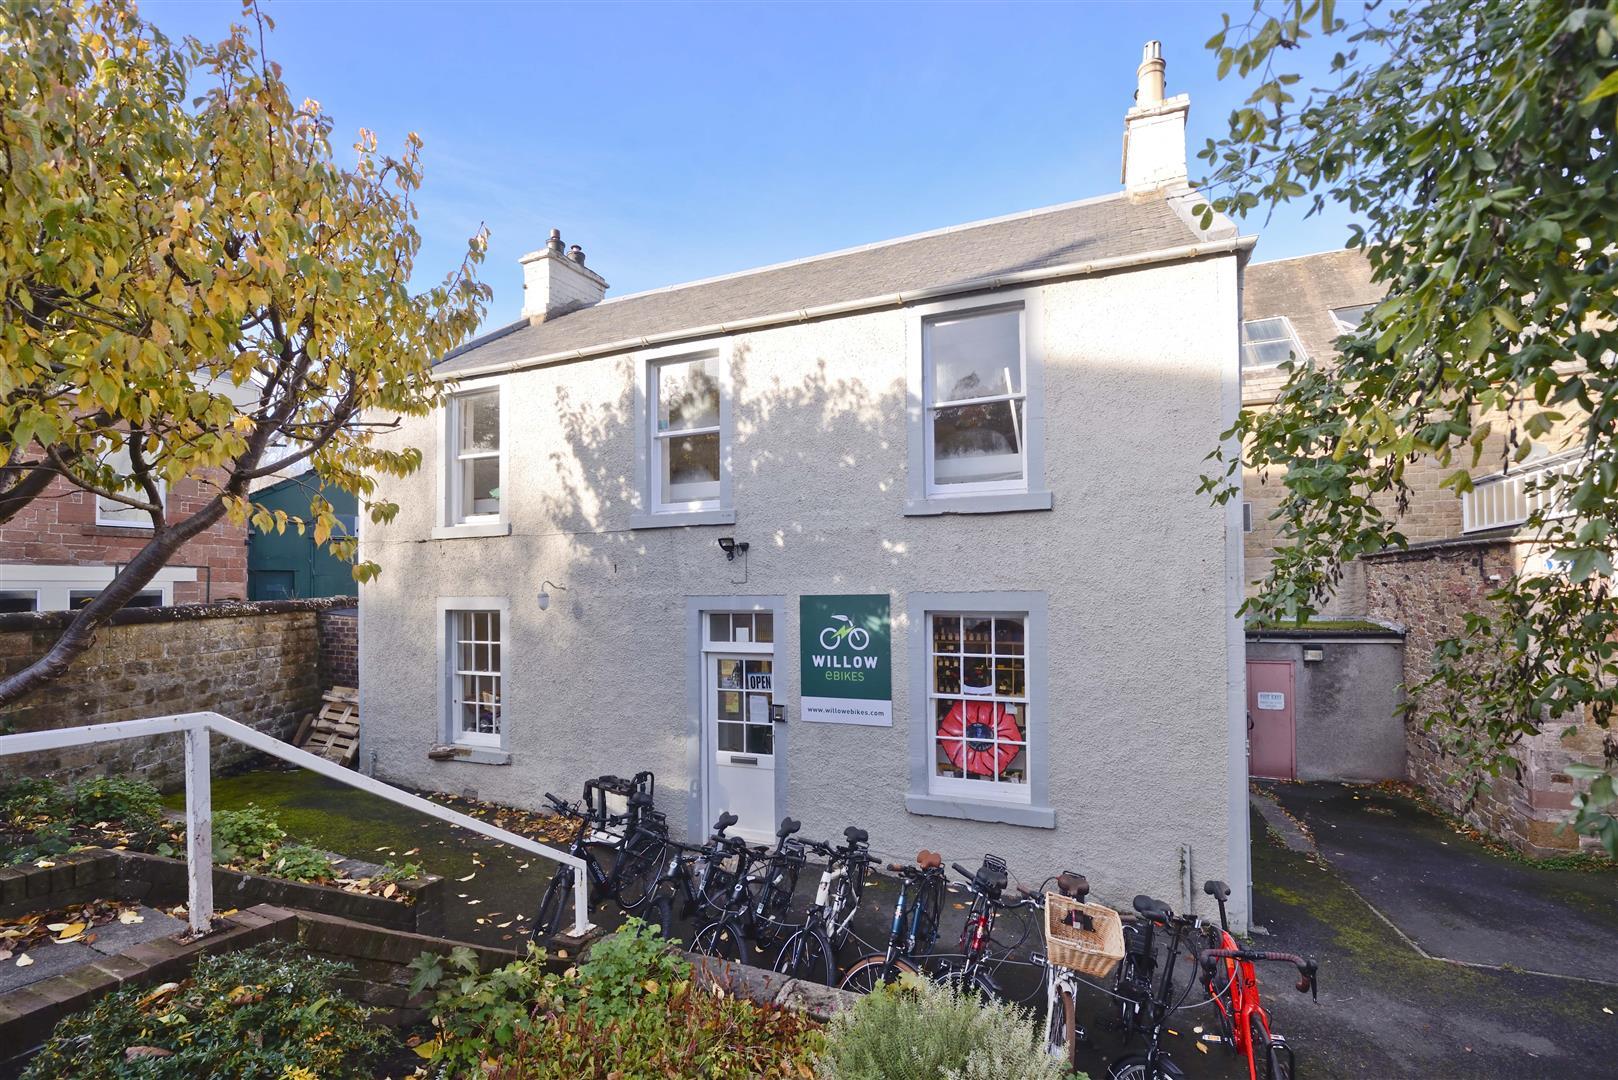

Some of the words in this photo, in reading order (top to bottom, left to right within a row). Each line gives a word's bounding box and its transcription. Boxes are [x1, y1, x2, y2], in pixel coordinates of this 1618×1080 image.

[812, 654, 878, 669] WILLOW
[750, 675, 771, 689] OPEN
[825, 670, 865, 682] eBIKES
[807, 706, 885, 717] www.willowebikes.com
